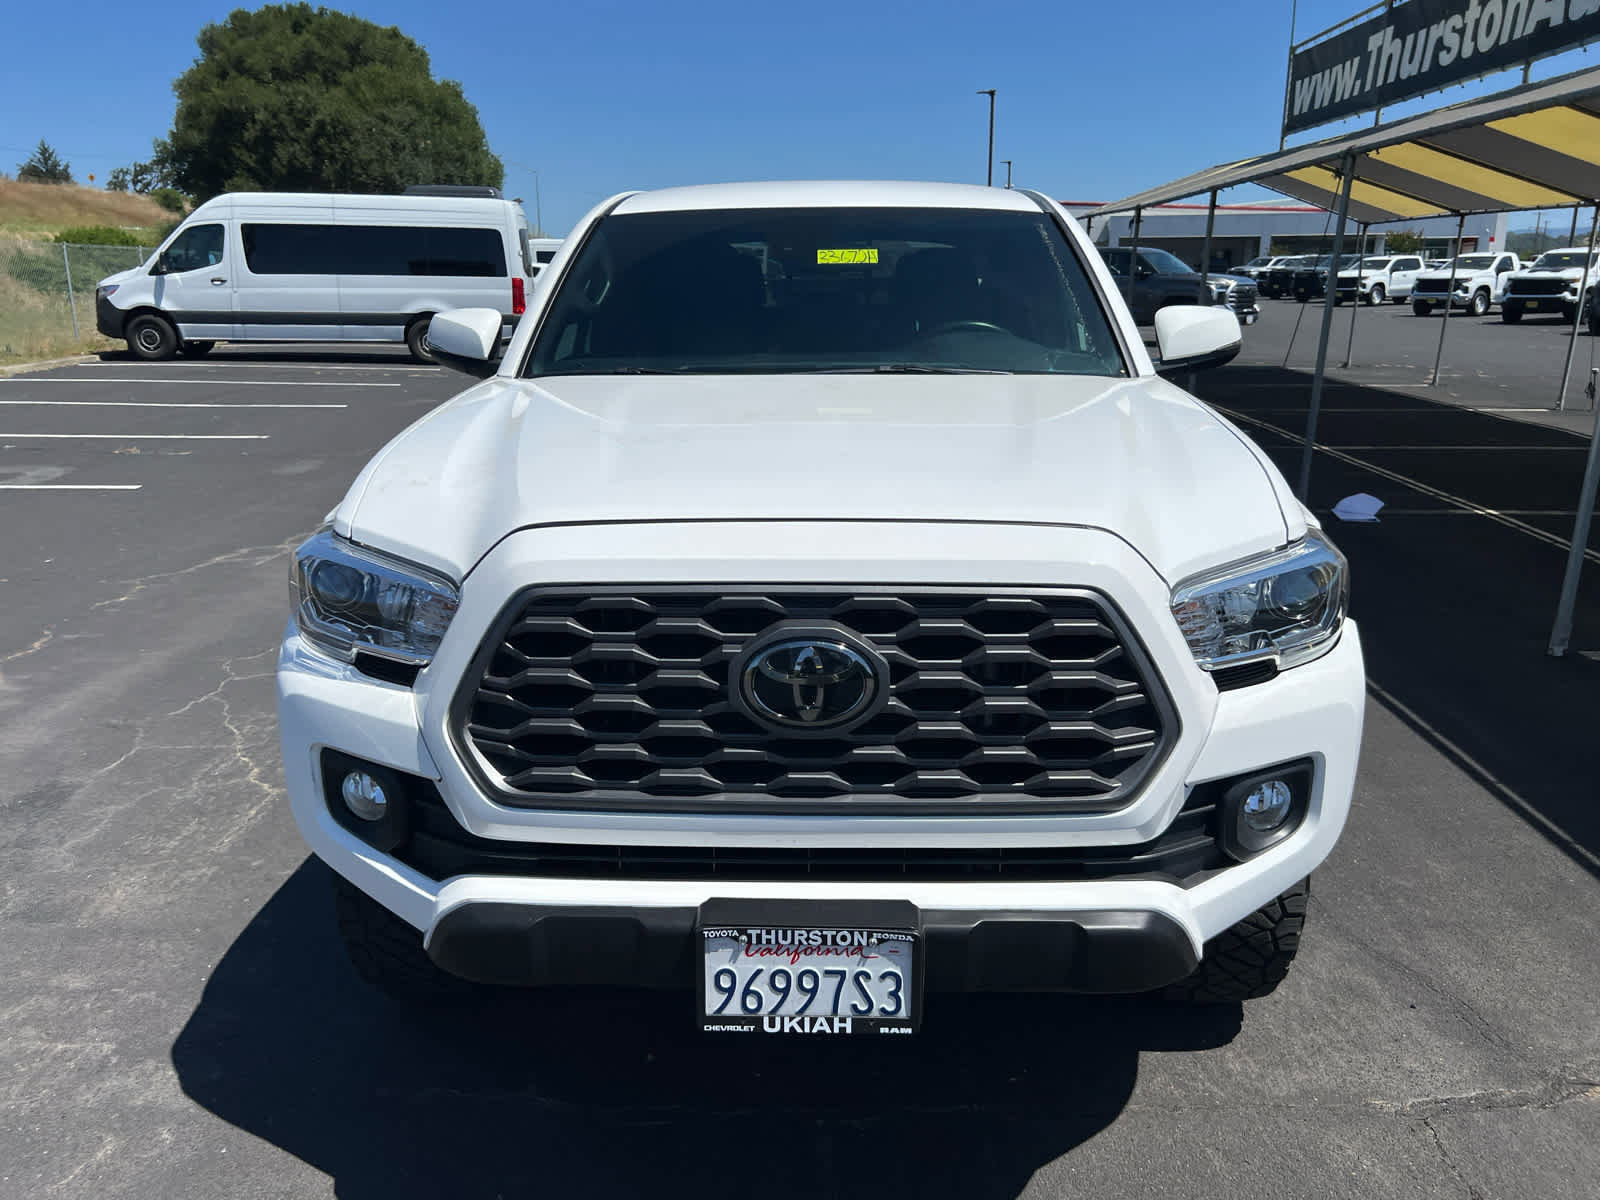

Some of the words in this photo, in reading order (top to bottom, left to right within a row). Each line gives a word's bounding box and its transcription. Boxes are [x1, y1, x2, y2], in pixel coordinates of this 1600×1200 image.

[703, 929, 739, 938] TOYOTA
[747, 929, 868, 946] THURSTON
[872, 932, 915, 942] HONDA
[744, 943, 878, 965] California
[712, 968, 903, 1016] 96997S3
[704, 1024, 755, 1032] CHEVROLET
[763, 1016, 852, 1034] UKIAH
